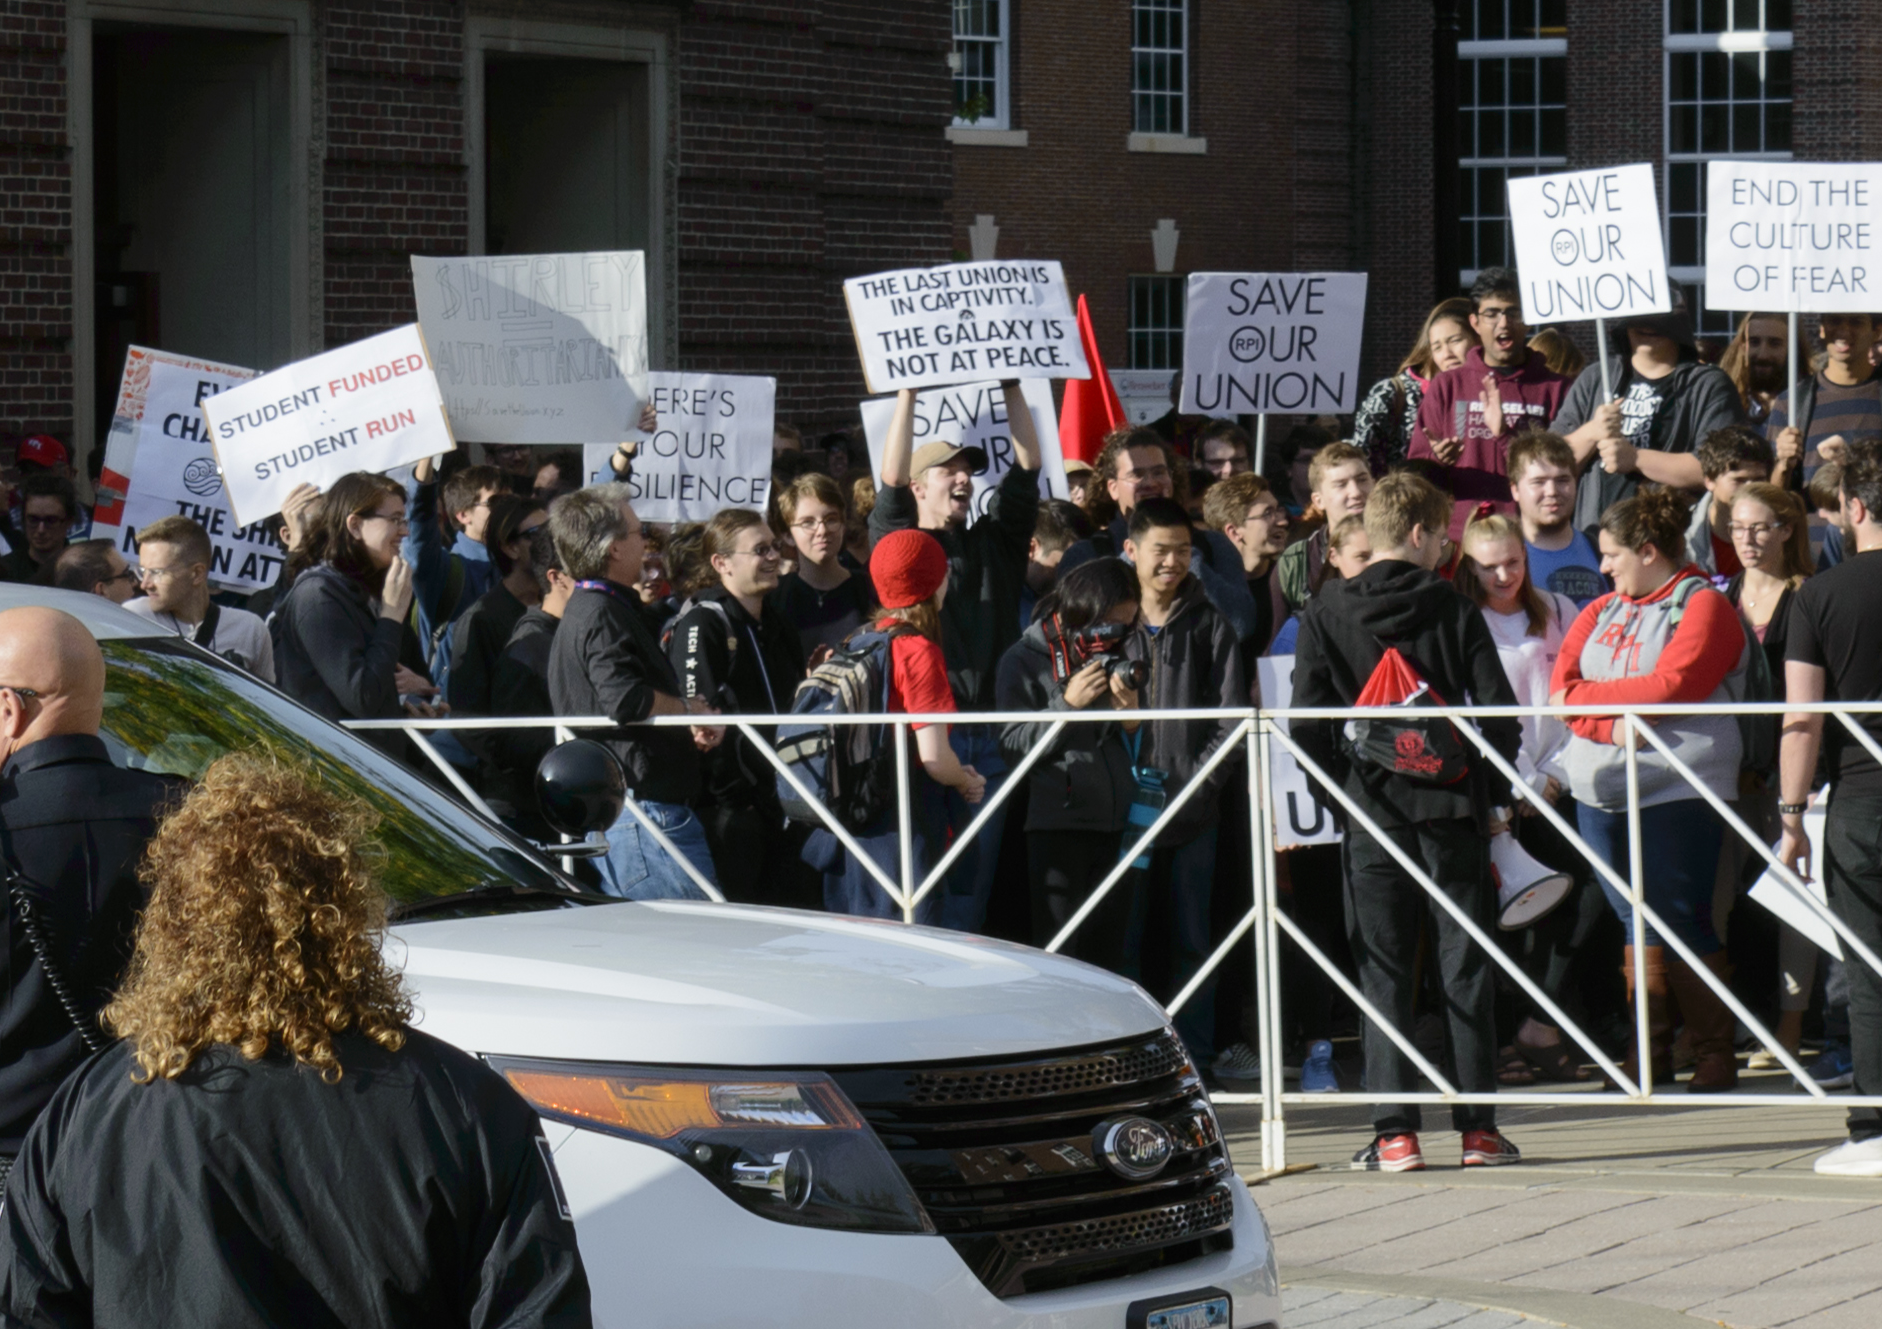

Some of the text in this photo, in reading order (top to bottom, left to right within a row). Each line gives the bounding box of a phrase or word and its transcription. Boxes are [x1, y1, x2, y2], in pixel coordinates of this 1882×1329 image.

[1542, 174, 1622, 219] SAVE
[1733, 179, 1868, 206] END THE
[1551, 224, 1625, 267] OUR
[1730, 221, 1870, 250] CULTURE
[857, 266, 1051, 300] THE LAST UNION IS
[1531, 269, 1656, 317] UNION
[1734, 264, 1868, 293] OF FEAR
[890, 286, 1033, 316] IN CAPTIVITY.
[1227, 278, 1327, 316] SAVE
[877, 319, 1064, 353] THE GALAXY IS
[1229, 325, 1318, 363] OUR
[1235, 338, 1259, 351] RPI
[886, 346, 1070, 379] NOT AT PEACE.
[219, 385, 321, 439] STUDENT
[328, 353, 424, 398] FUNDED
[654, 387, 735, 418] ERE'S
[1195, 371, 1345, 410] UNION
[913, 386, 1009, 437] SAVE
[254, 427, 359, 481] STUDENT
[365, 409, 416, 439] RUN
[591, 471, 766, 504] SILIENCE
[176, 500, 227, 534] THE
[687, 625, 699, 653] TECH
[1596, 623, 1643, 672] RPI
[1128, 1125, 1167, 1162] Ford
